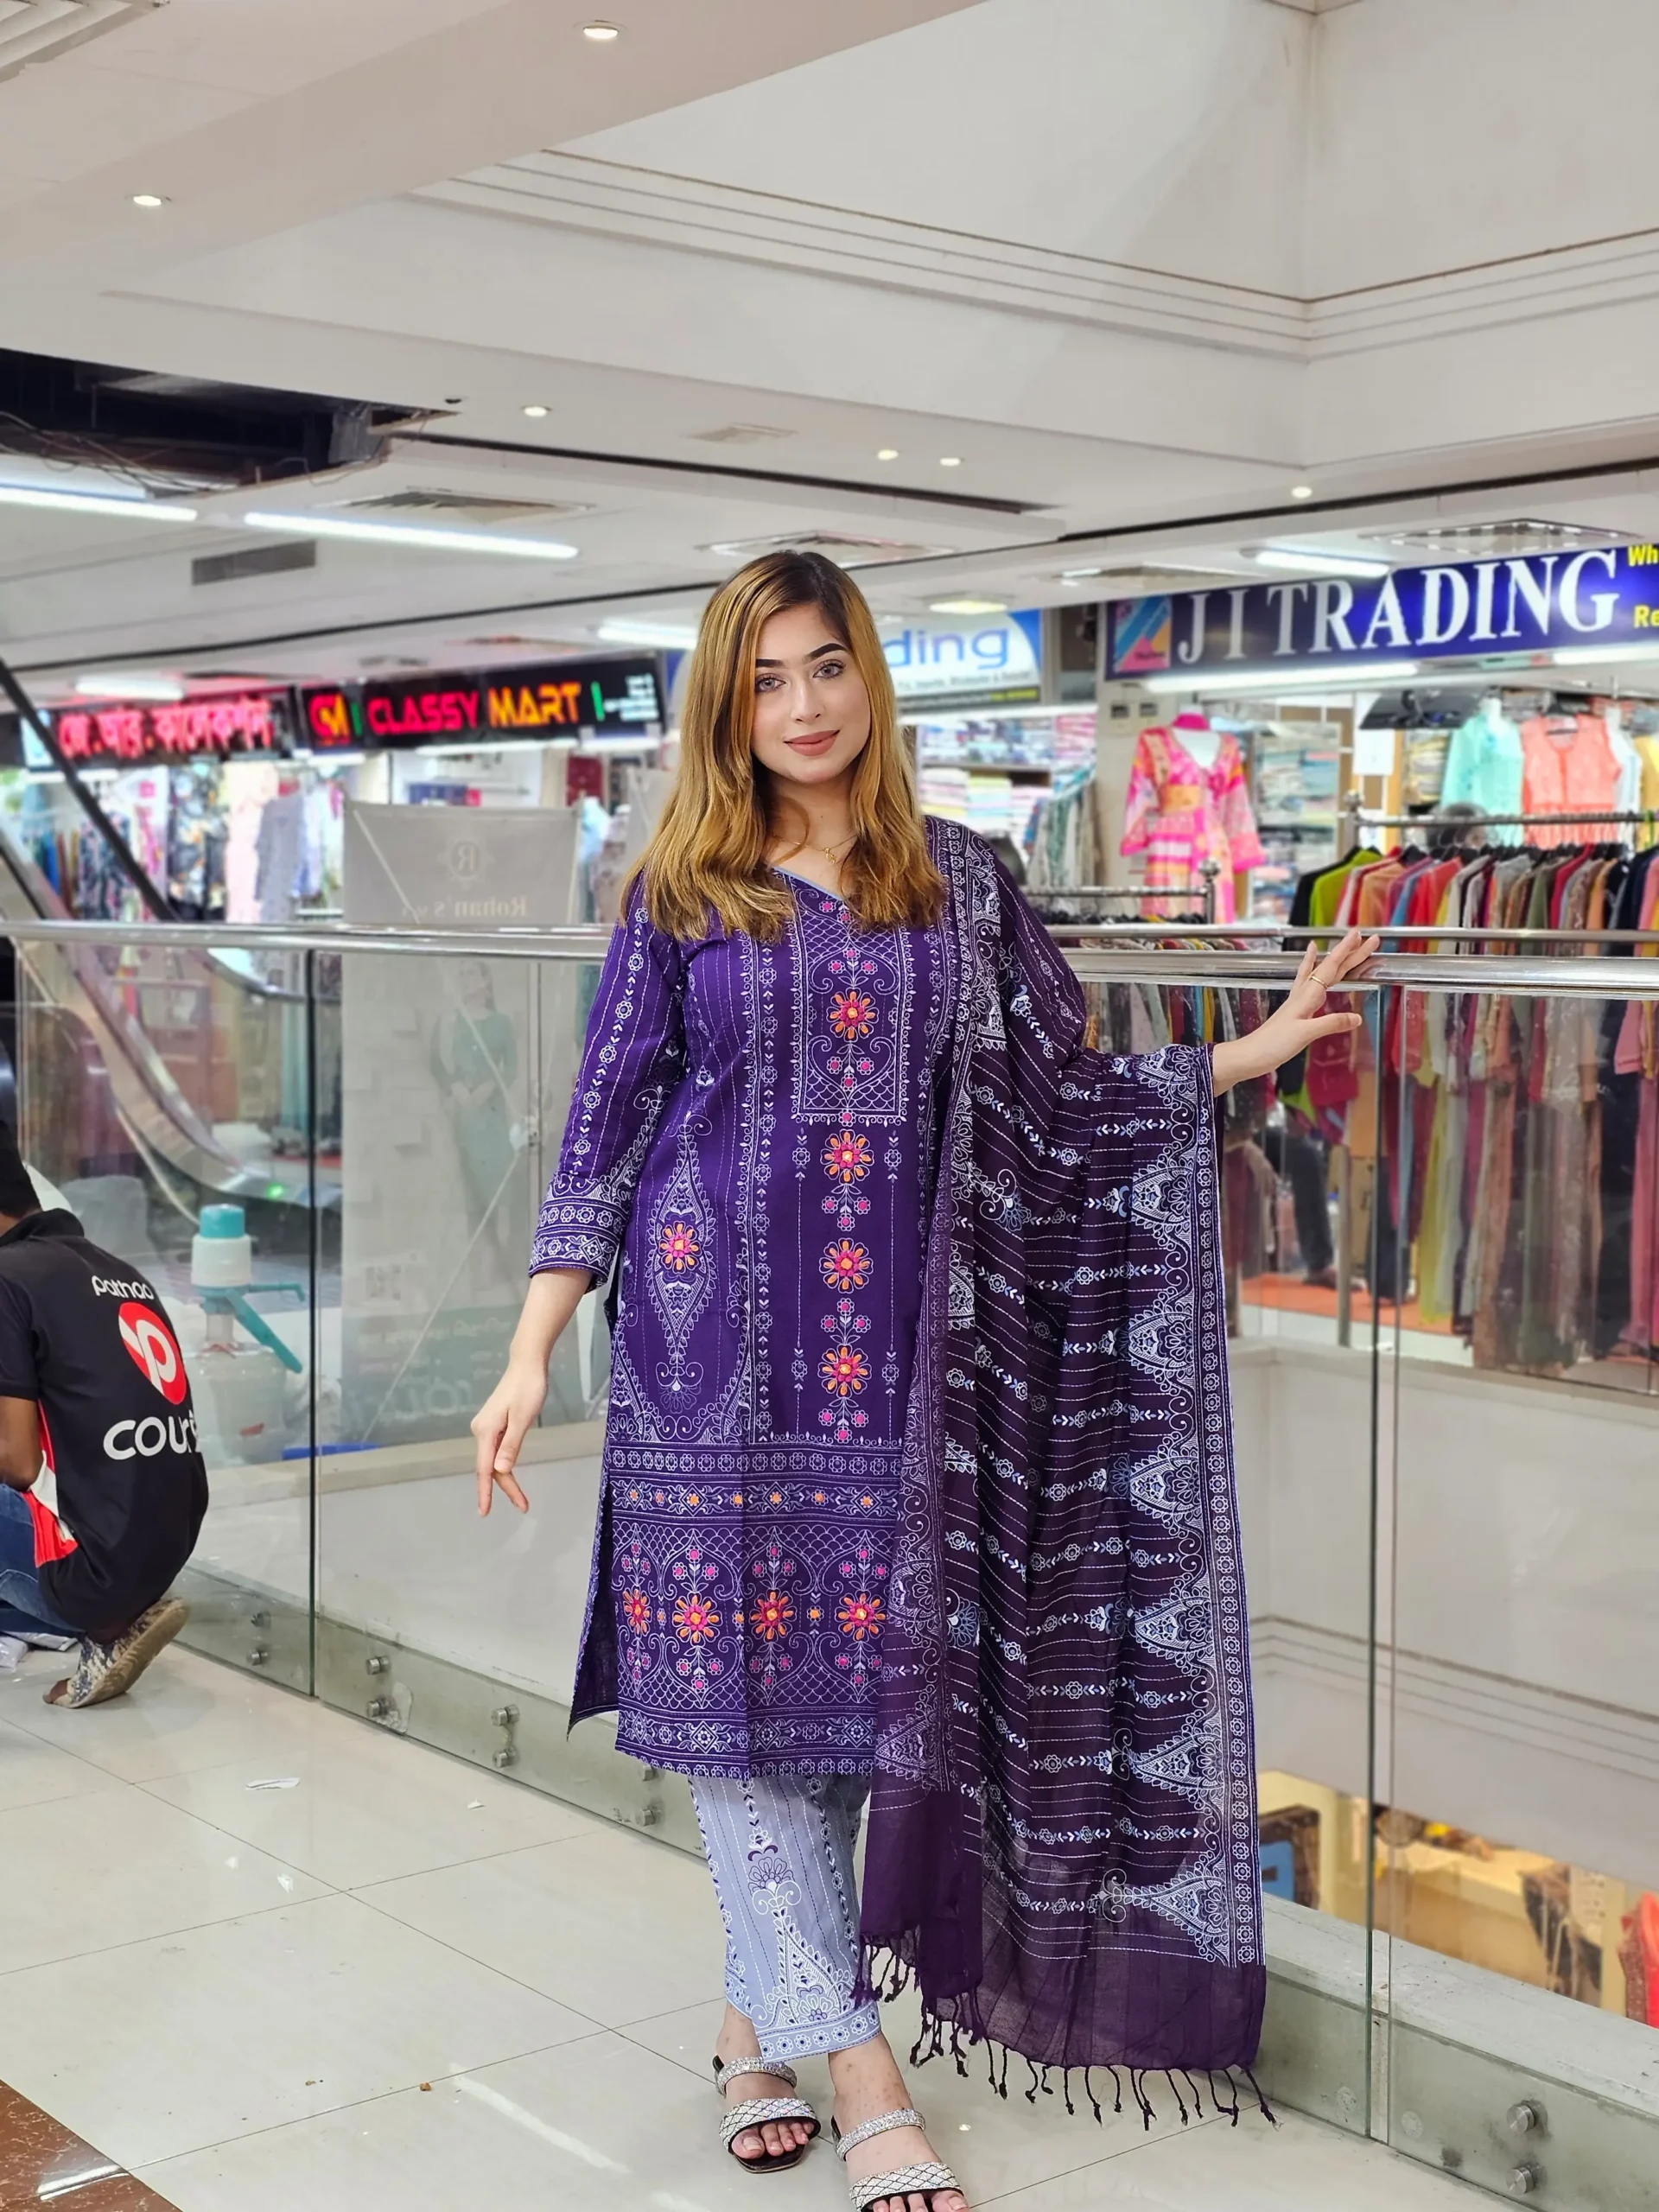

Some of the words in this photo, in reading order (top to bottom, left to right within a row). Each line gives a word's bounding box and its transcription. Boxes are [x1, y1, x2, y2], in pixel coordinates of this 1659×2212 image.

[1266, 549, 1620, 657] TRADING
[367, 690, 480, 735] CLASSY
[487, 681, 582, 728] MART
